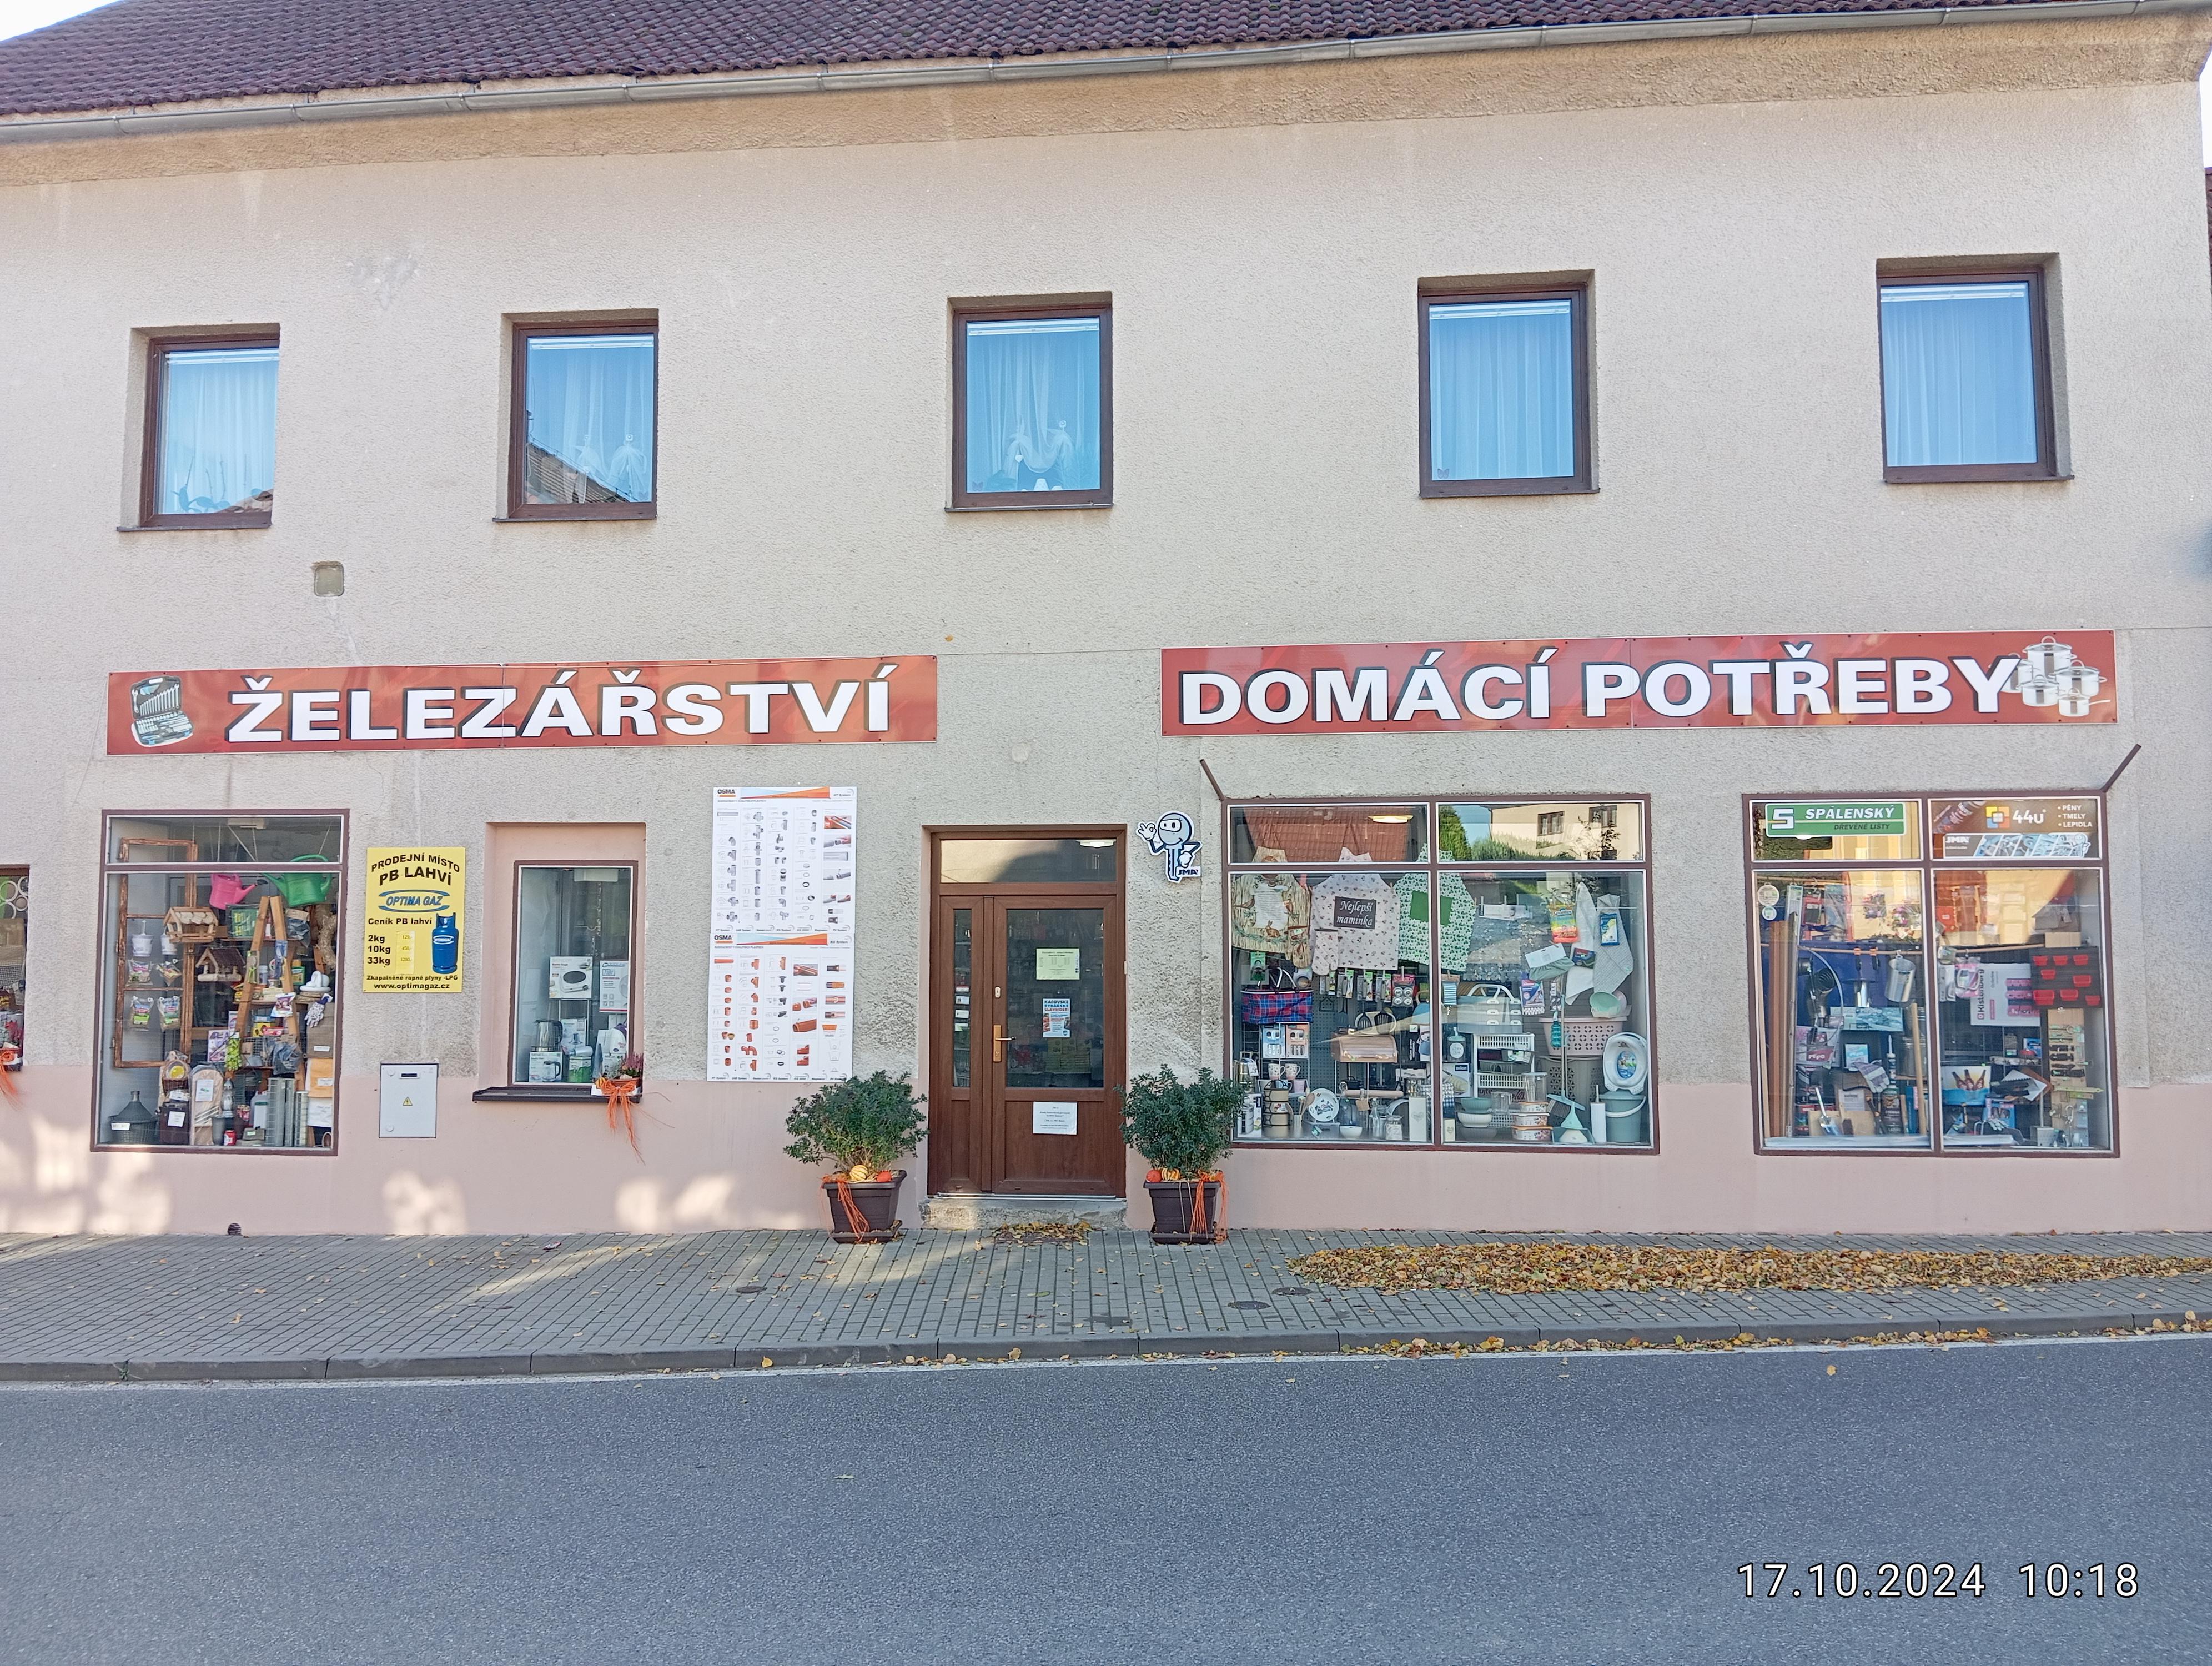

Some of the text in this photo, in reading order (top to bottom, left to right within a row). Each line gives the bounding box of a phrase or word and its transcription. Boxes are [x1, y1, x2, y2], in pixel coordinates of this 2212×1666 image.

[1180, 641, 2022, 724] DOMÁCÍ POTŘEBY
[226, 664, 898, 742] ŽELEZÁŘSTVÍ
[1805, 805, 1894, 819] SPÁLENSKÝ
[371, 852, 460, 872] PRODEJNÍ MÍSTO
[380, 866, 451, 886] PB LAHVÍ
[386, 896, 443, 906] OPTIMA GAZ
[1339, 901, 1373, 915] Nejlepší
[1336, 915, 1373, 927] maminka
[368, 935, 385, 944] 2kg
[368, 945, 391, 954] 10kg
[367, 957, 390, 966] 33kg
